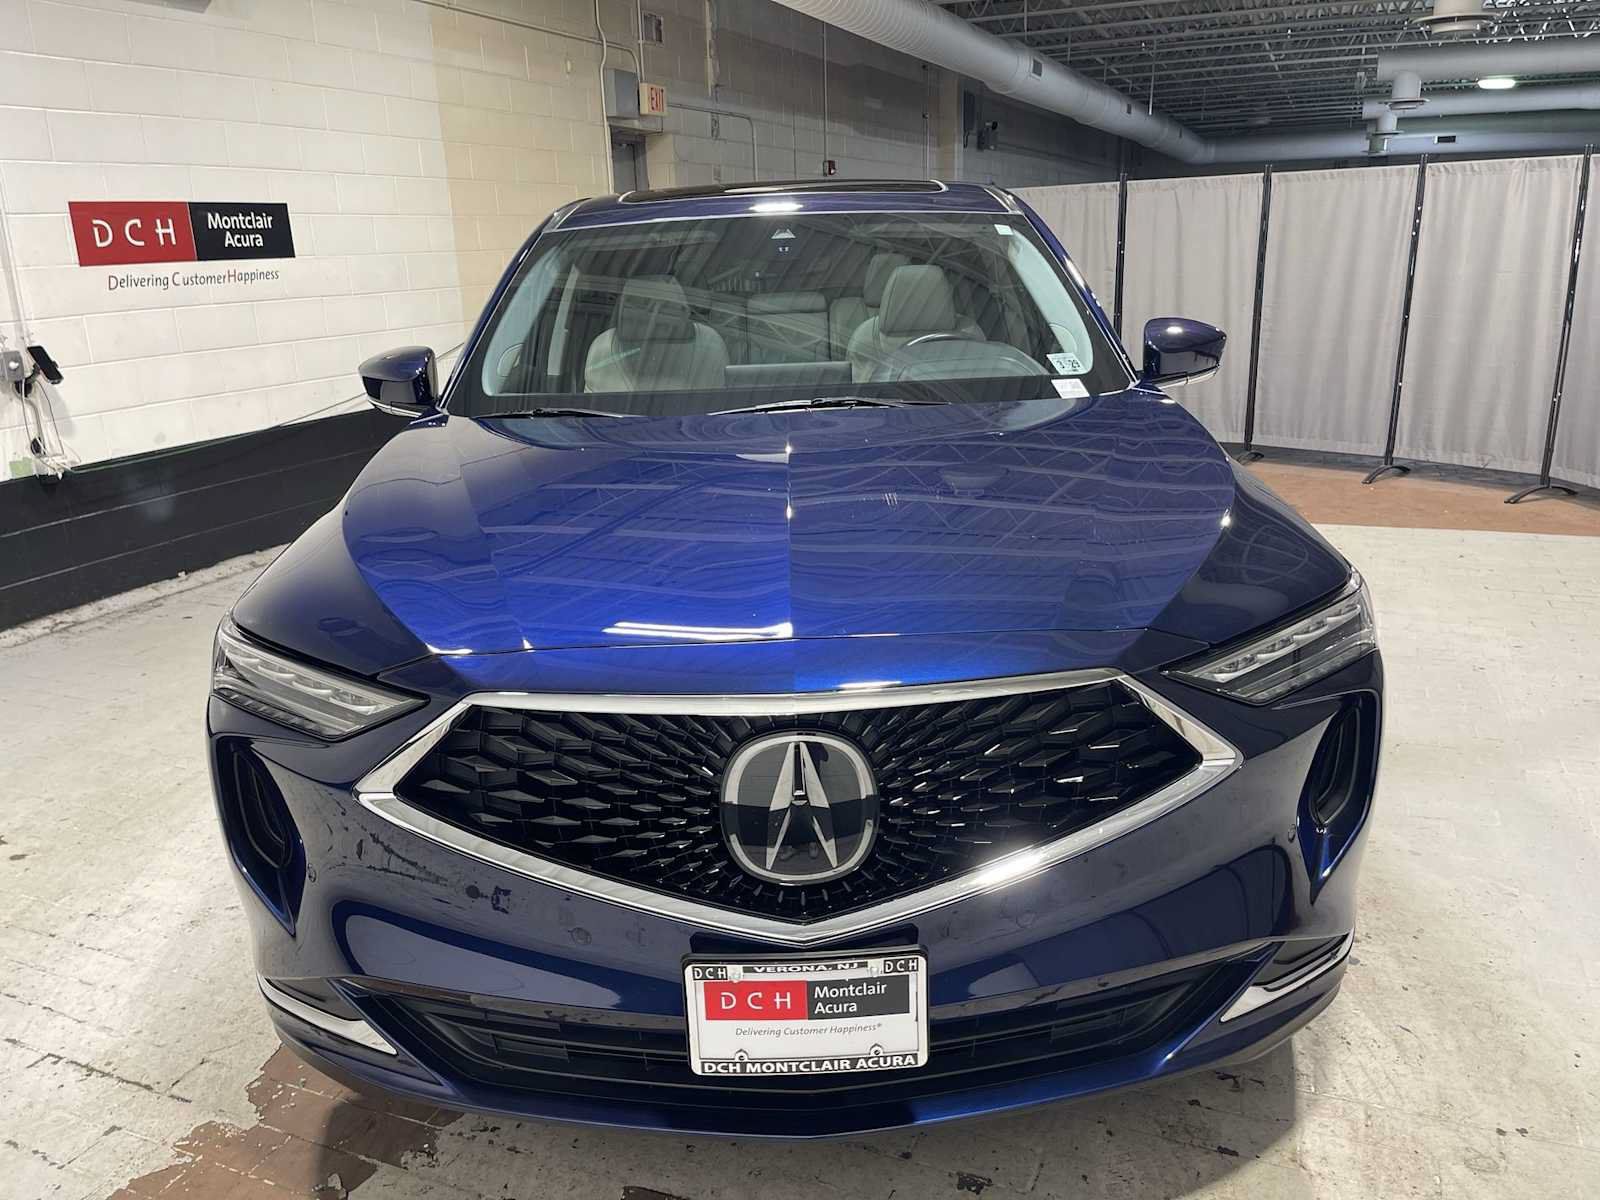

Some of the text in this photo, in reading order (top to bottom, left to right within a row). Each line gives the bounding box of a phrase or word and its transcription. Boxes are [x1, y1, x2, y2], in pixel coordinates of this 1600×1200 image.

[650, 87, 664, 112] EXIT
[207, 212, 273, 230] Montclair
[224, 231, 264, 248] Acura
[107, 274, 169, 291] Delivering
[837, 962, 858, 970] NJ
[814, 981, 887, 999] Montclair
[814, 1002, 857, 1014] Acura
[735, 1026, 781, 1038] Delivering
[783, 1025, 828, 1036] Customer
[703, 1054, 916, 1073] DCH MONTCLAIR ACURA
